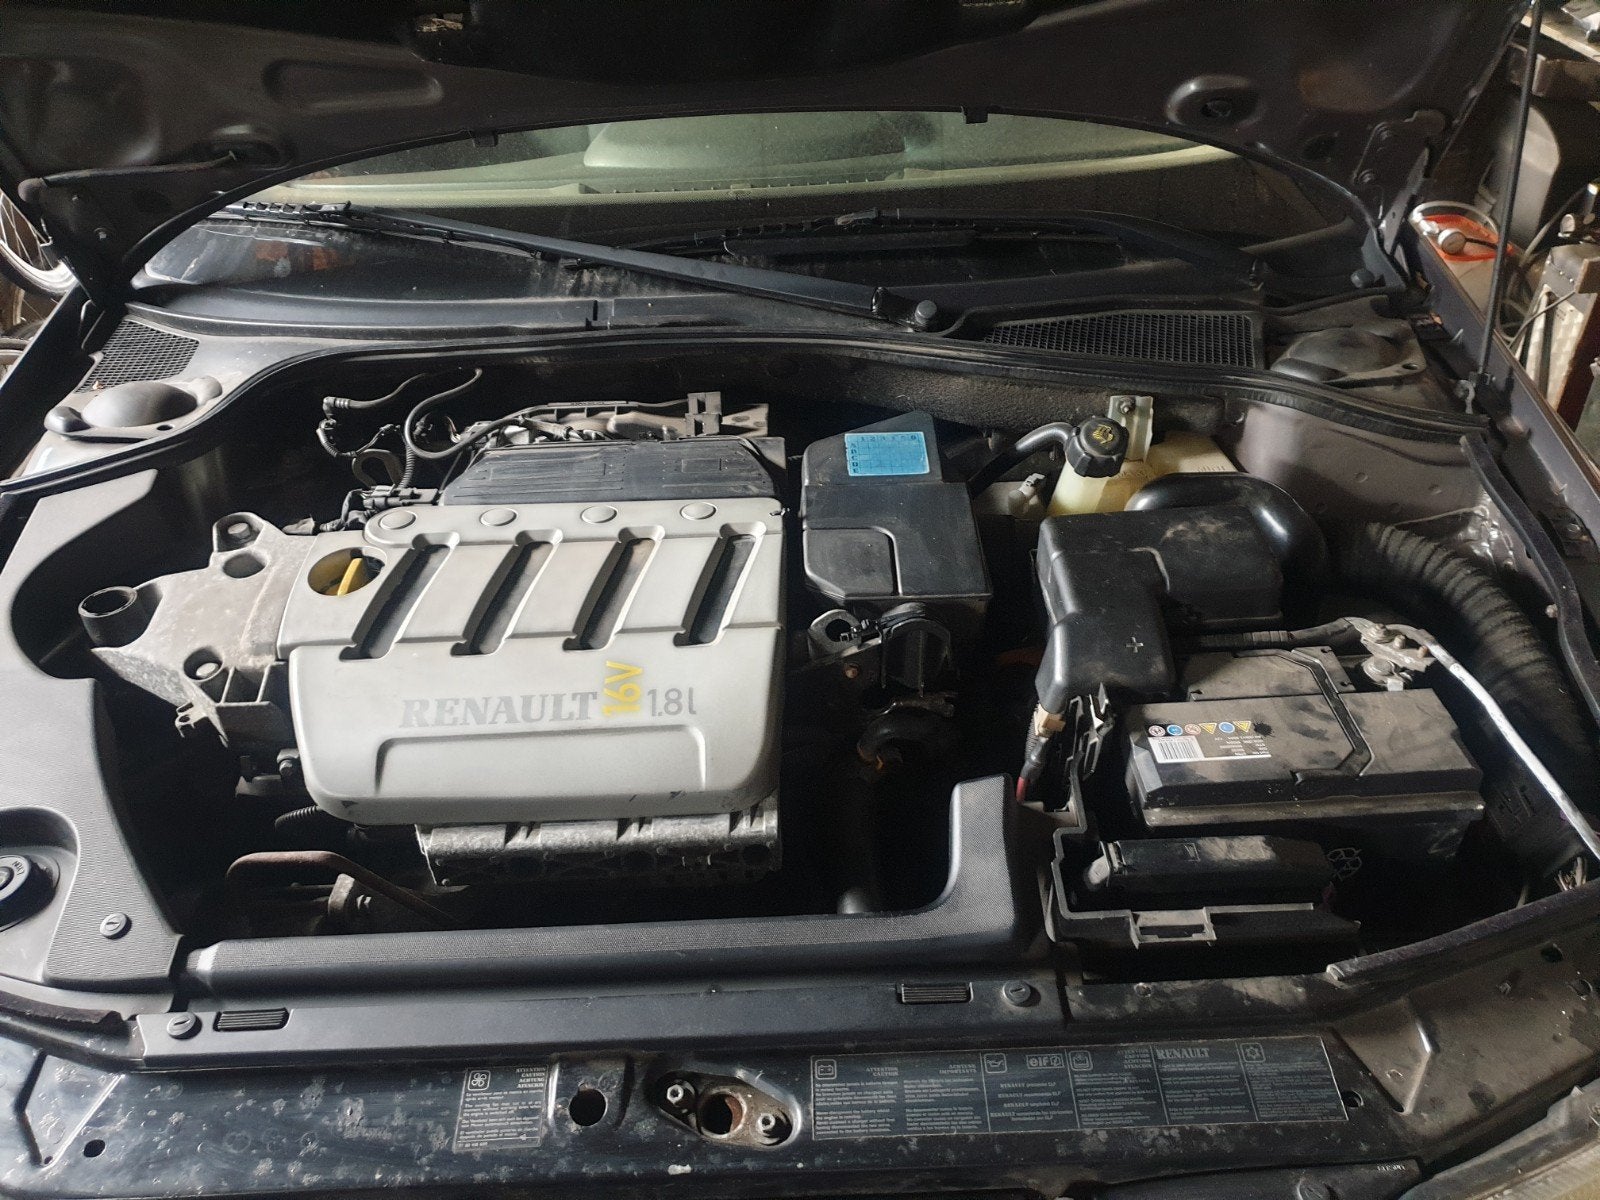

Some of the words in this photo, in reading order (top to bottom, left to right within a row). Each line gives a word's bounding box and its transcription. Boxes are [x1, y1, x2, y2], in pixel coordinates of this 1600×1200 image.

[602, 660, 643, 717] 16V
[399, 691, 598, 728] RENAULT
[1156, 1047, 1210, 1060] RENAULT
